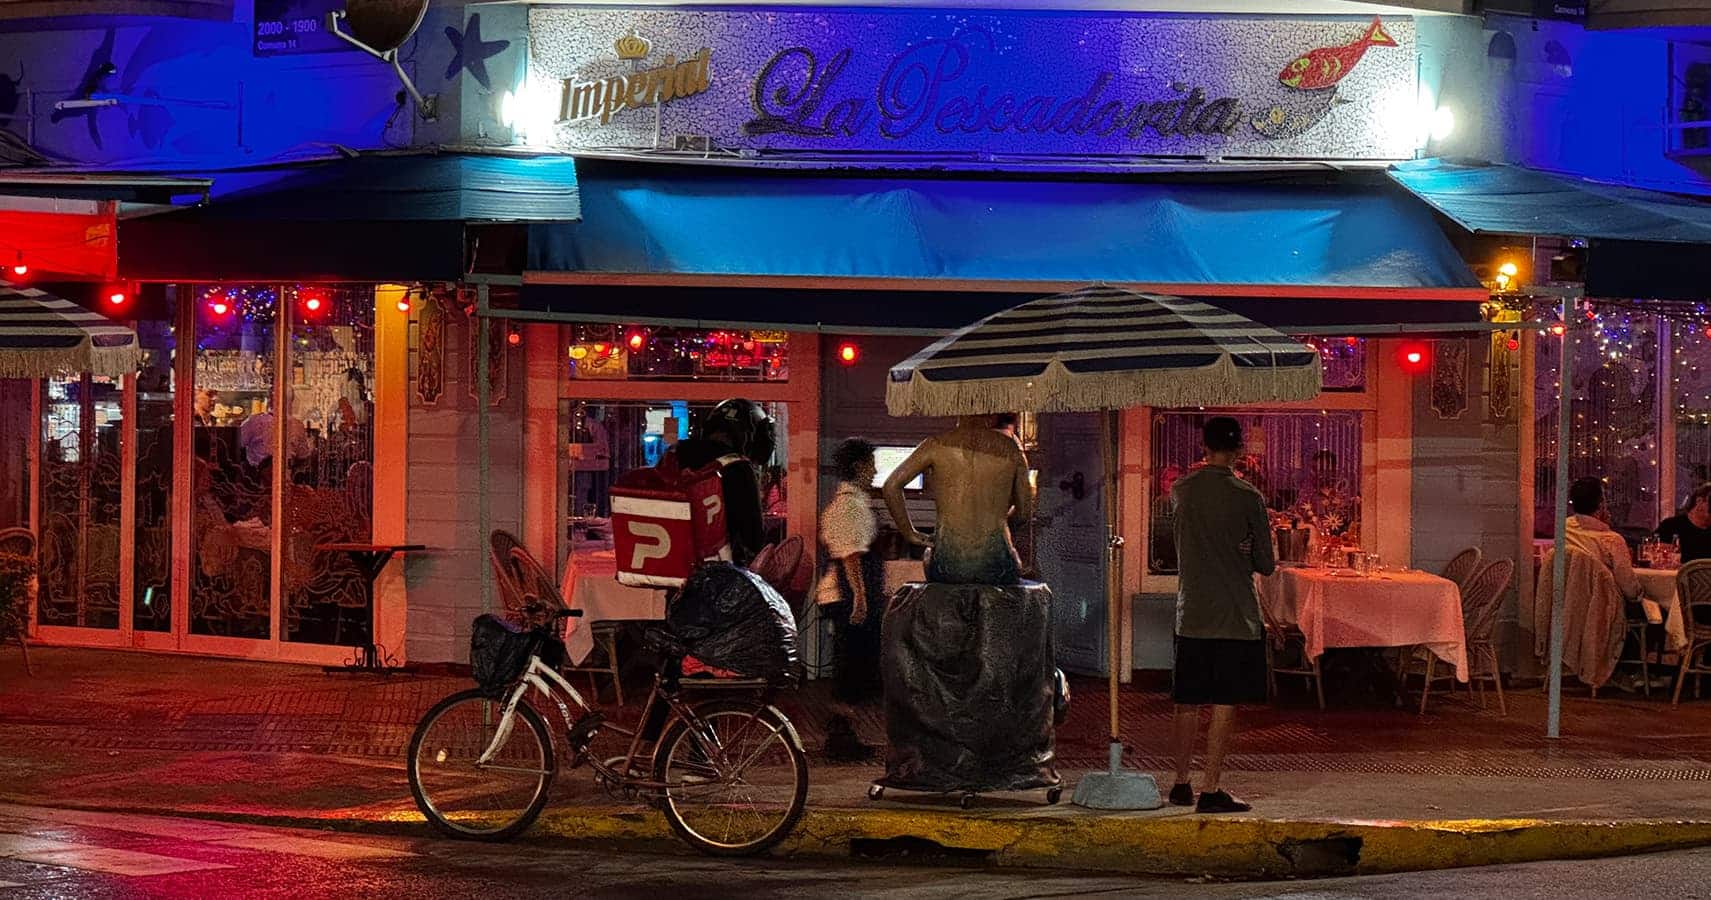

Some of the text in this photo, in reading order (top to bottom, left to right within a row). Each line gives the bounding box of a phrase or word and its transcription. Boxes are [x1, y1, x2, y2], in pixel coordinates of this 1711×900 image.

[258, 21, 283, 35] 2000
[293, 19, 317, 33] 1900
[555, 47, 712, 125] Imperial
[740, 33, 1242, 138] La Pescadorita
